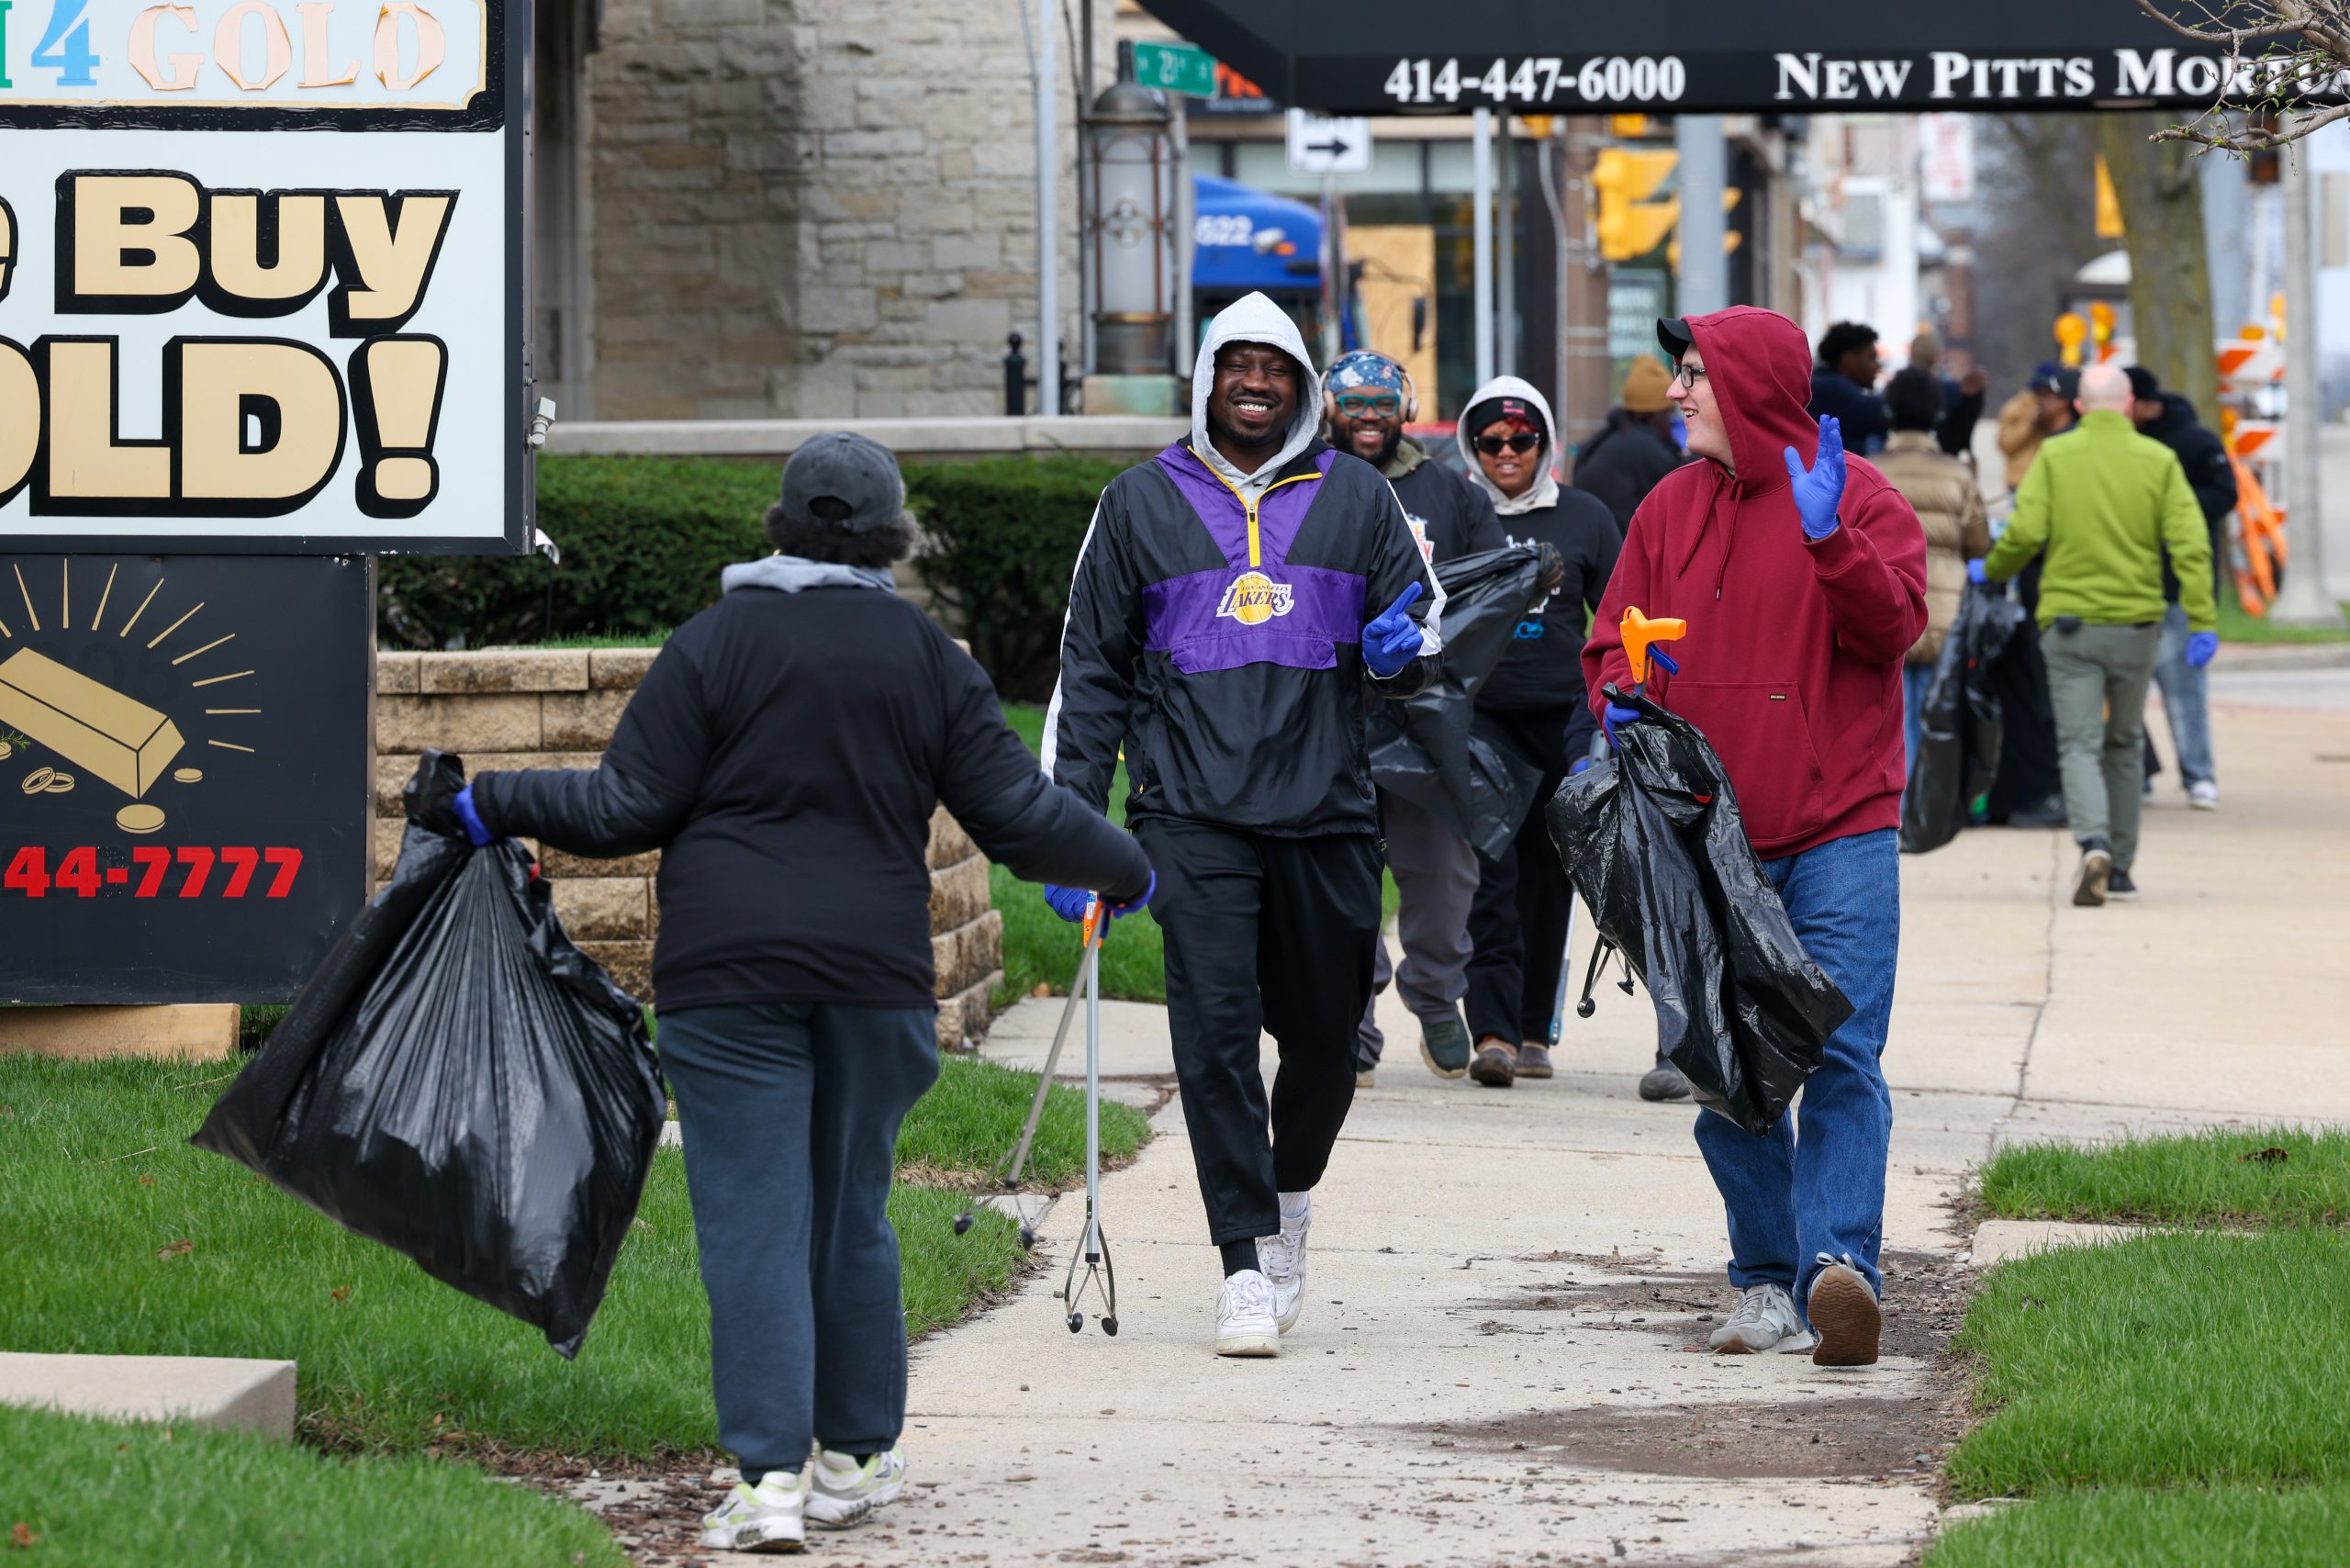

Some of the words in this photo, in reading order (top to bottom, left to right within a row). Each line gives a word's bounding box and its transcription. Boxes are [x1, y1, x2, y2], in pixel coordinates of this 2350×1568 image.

[31, 0, 100, 86] 4
[128, 3, 445, 90] GOLD
[1383, 56, 1686, 103] 414-447-6000
[55, 169, 460, 339] Buy
[0, 333, 448, 519] LD!
[1222, 588, 1292, 613] LAKERS
[5, 846, 303, 898] 44-7777
